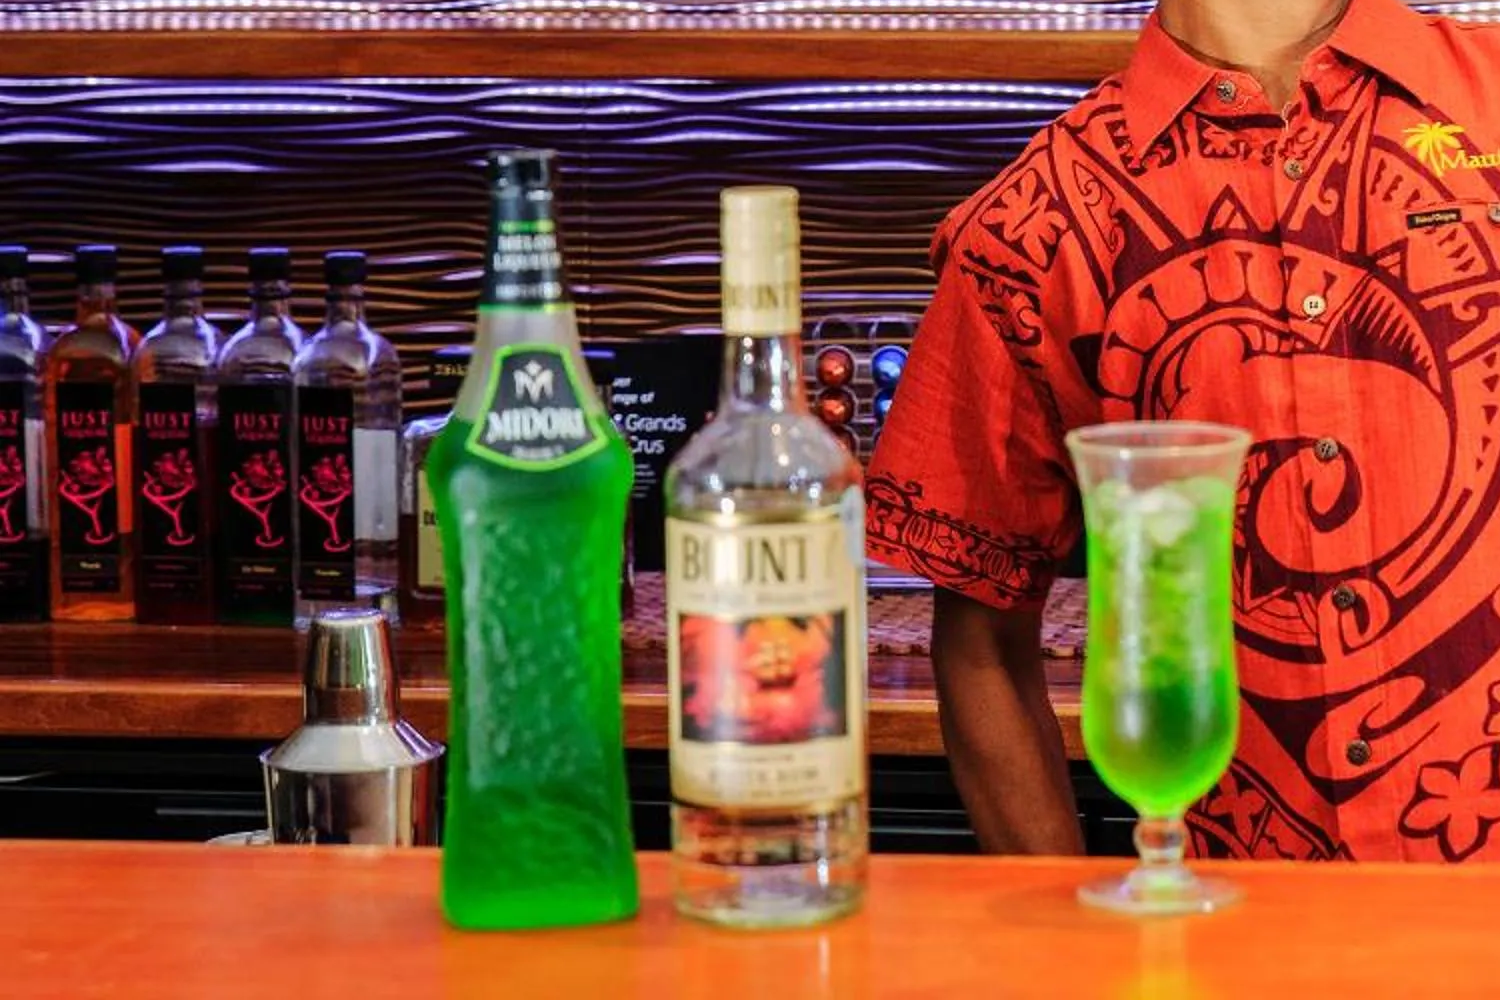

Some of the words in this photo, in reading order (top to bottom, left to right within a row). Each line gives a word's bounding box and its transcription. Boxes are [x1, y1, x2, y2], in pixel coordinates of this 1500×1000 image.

[62, 410, 109, 427] JUST
[144, 412, 191, 428] JUST
[234, 413, 281, 430] JUST
[303, 415, 350, 431] JUST
[486, 406, 586, 444] MIDORI
[625, 412, 687, 432] Grands
[630, 434, 666, 455] Crus
